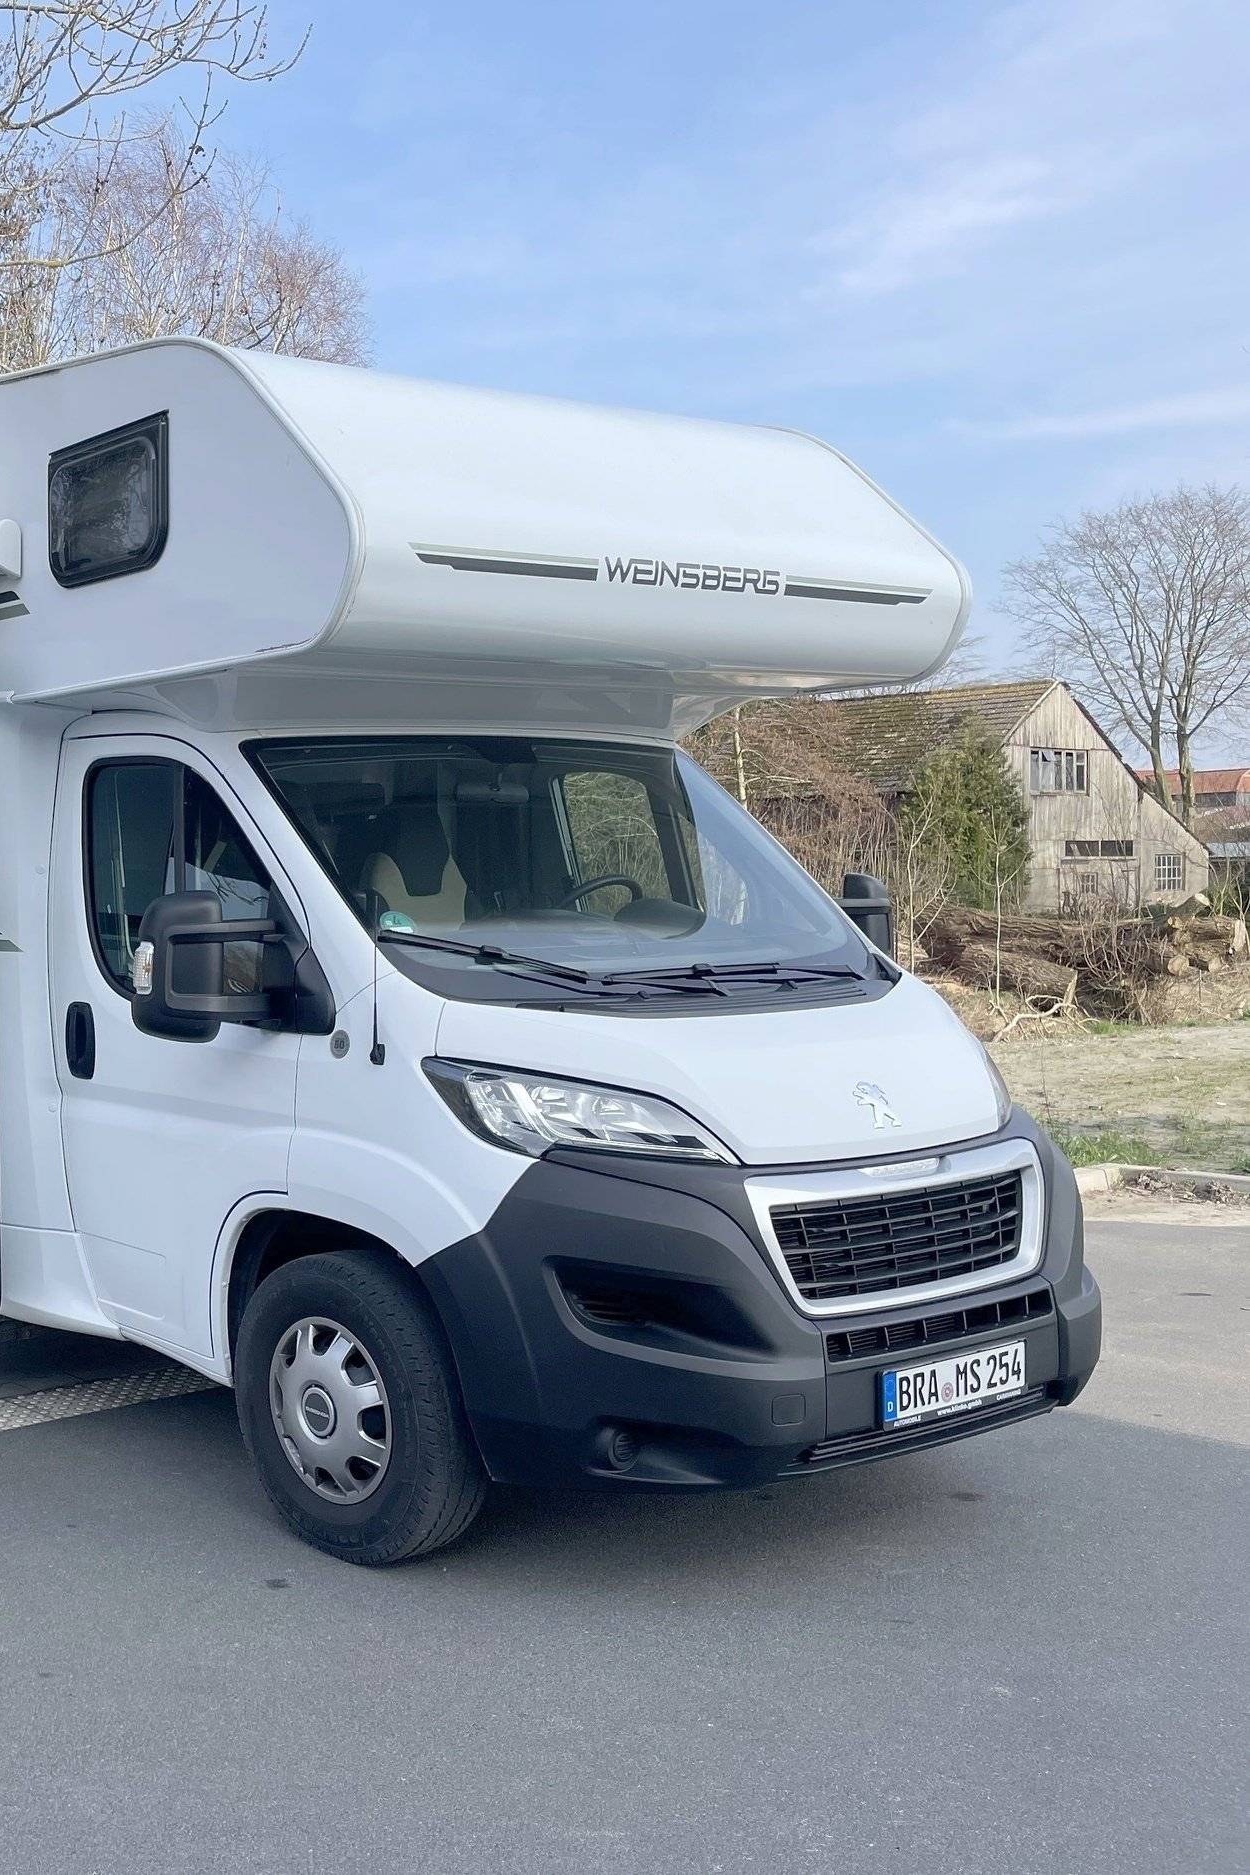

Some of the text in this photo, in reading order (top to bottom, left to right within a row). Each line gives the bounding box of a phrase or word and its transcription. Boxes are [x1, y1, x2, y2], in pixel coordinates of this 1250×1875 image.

[605, 556, 781, 595] WEINSBERG
[899, 1348, 1022, 1411] BRA MS 254
[887, 1401, 894, 1412] D
